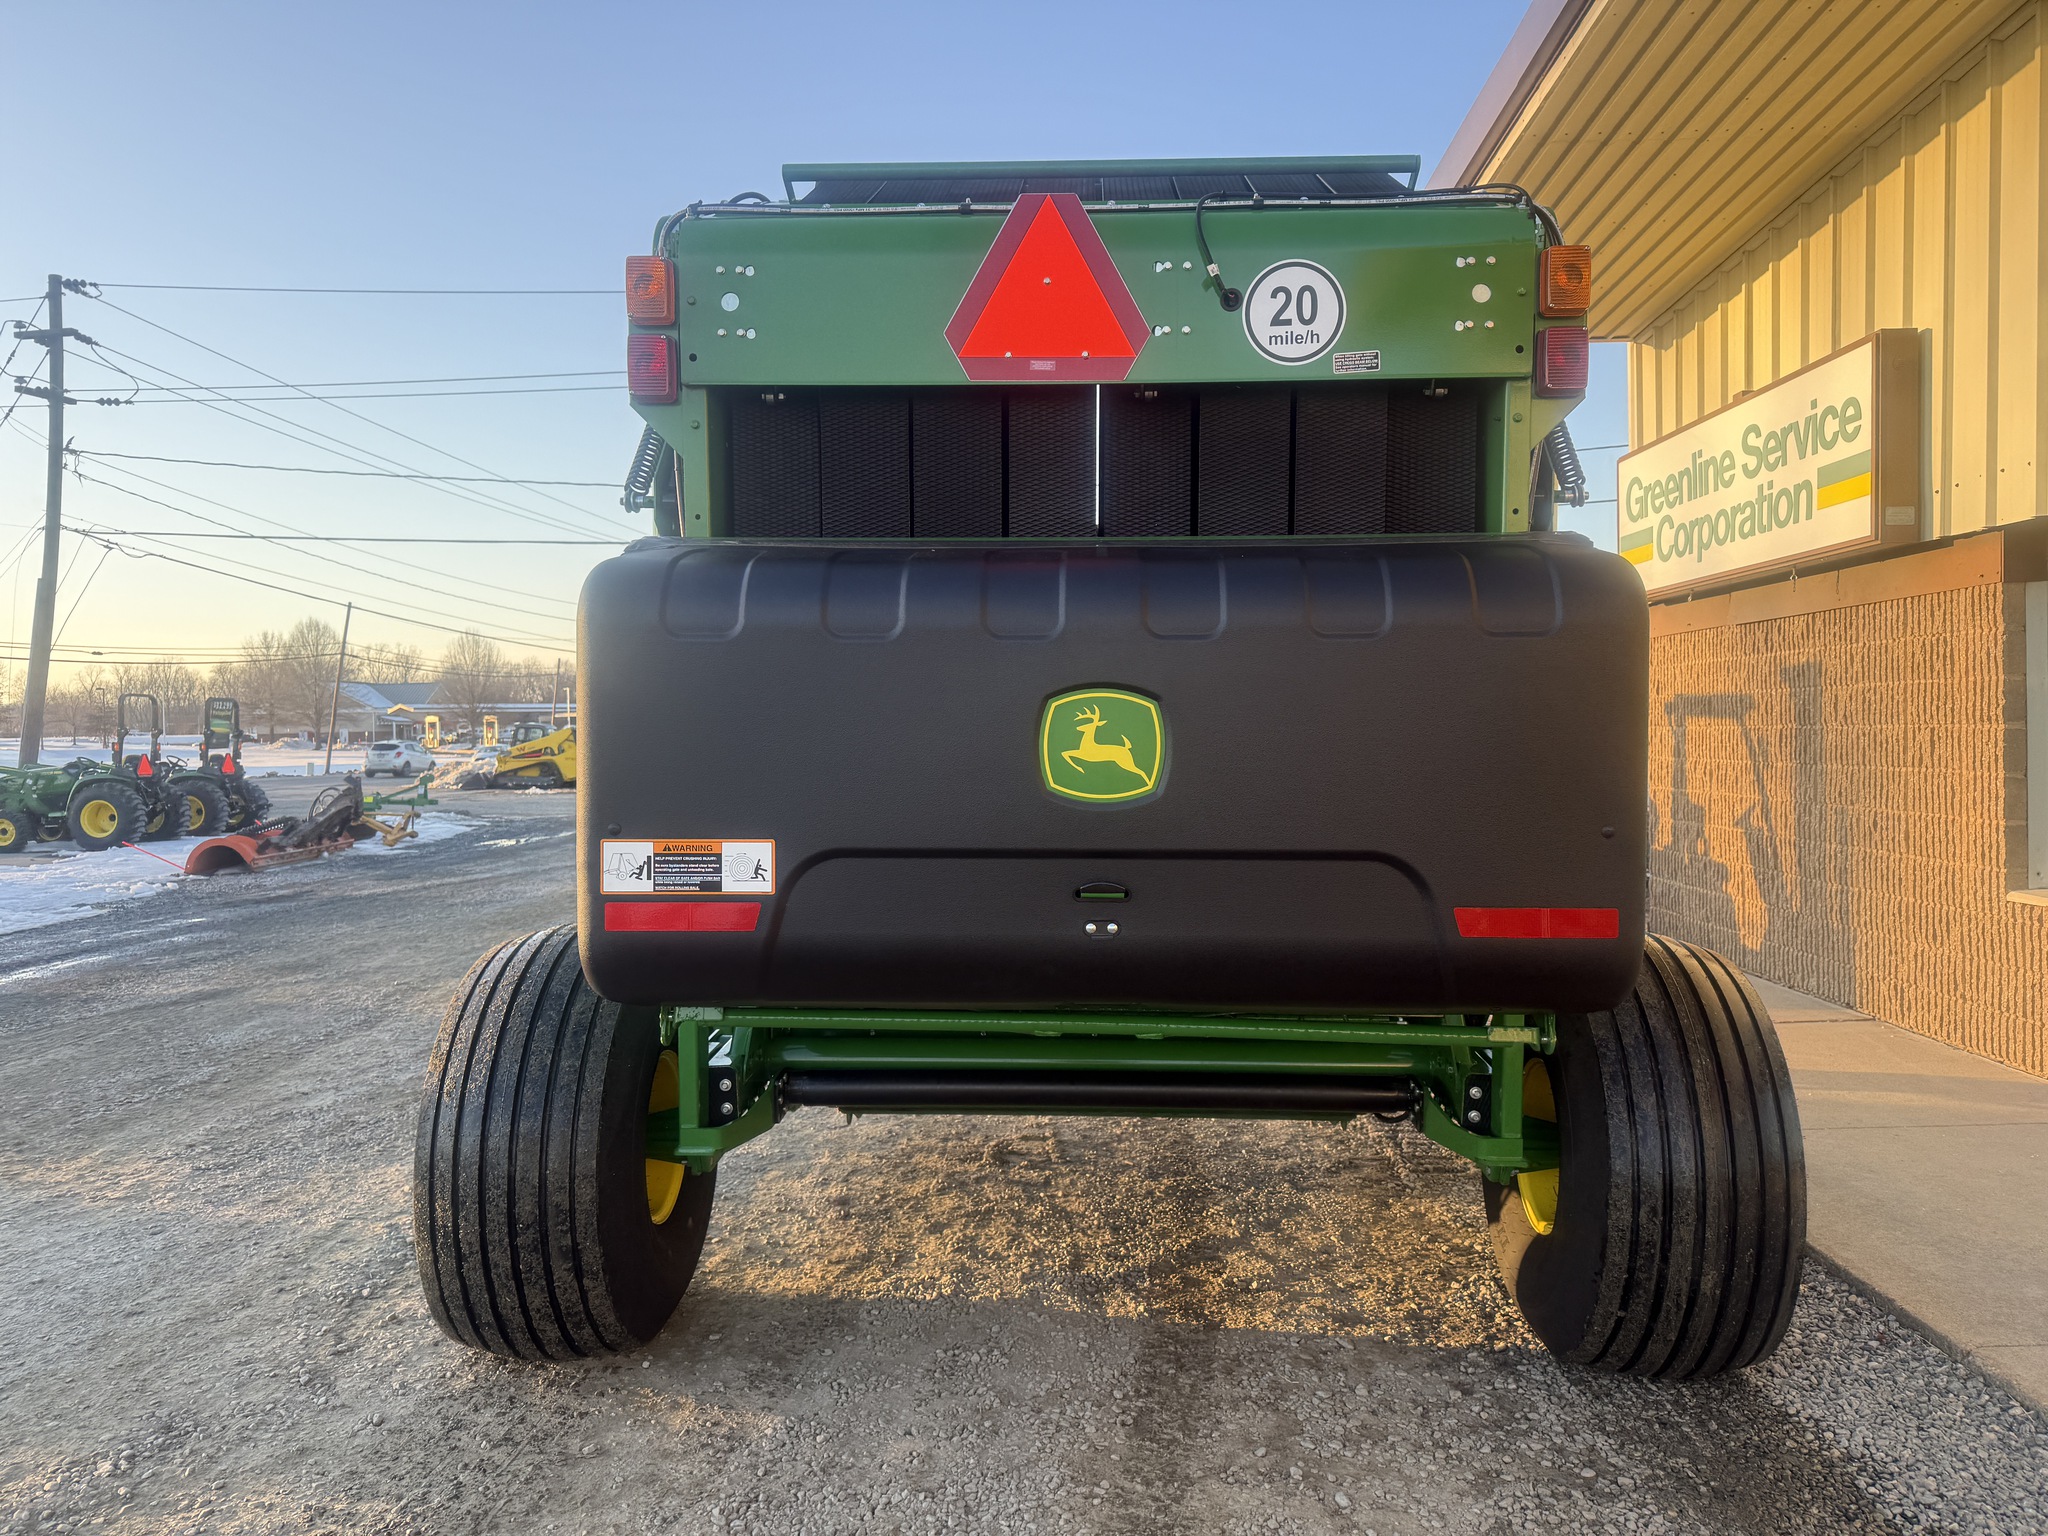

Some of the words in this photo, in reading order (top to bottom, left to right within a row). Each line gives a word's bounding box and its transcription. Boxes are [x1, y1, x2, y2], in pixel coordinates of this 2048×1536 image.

[1270, 284, 1318, 326] 20
[1268, 330, 1320, 346] mile/h
[1626, 449, 1736, 523] Greenline
[1741, 396, 1862, 479] Service
[1656, 478, 1813, 563] Corporation
